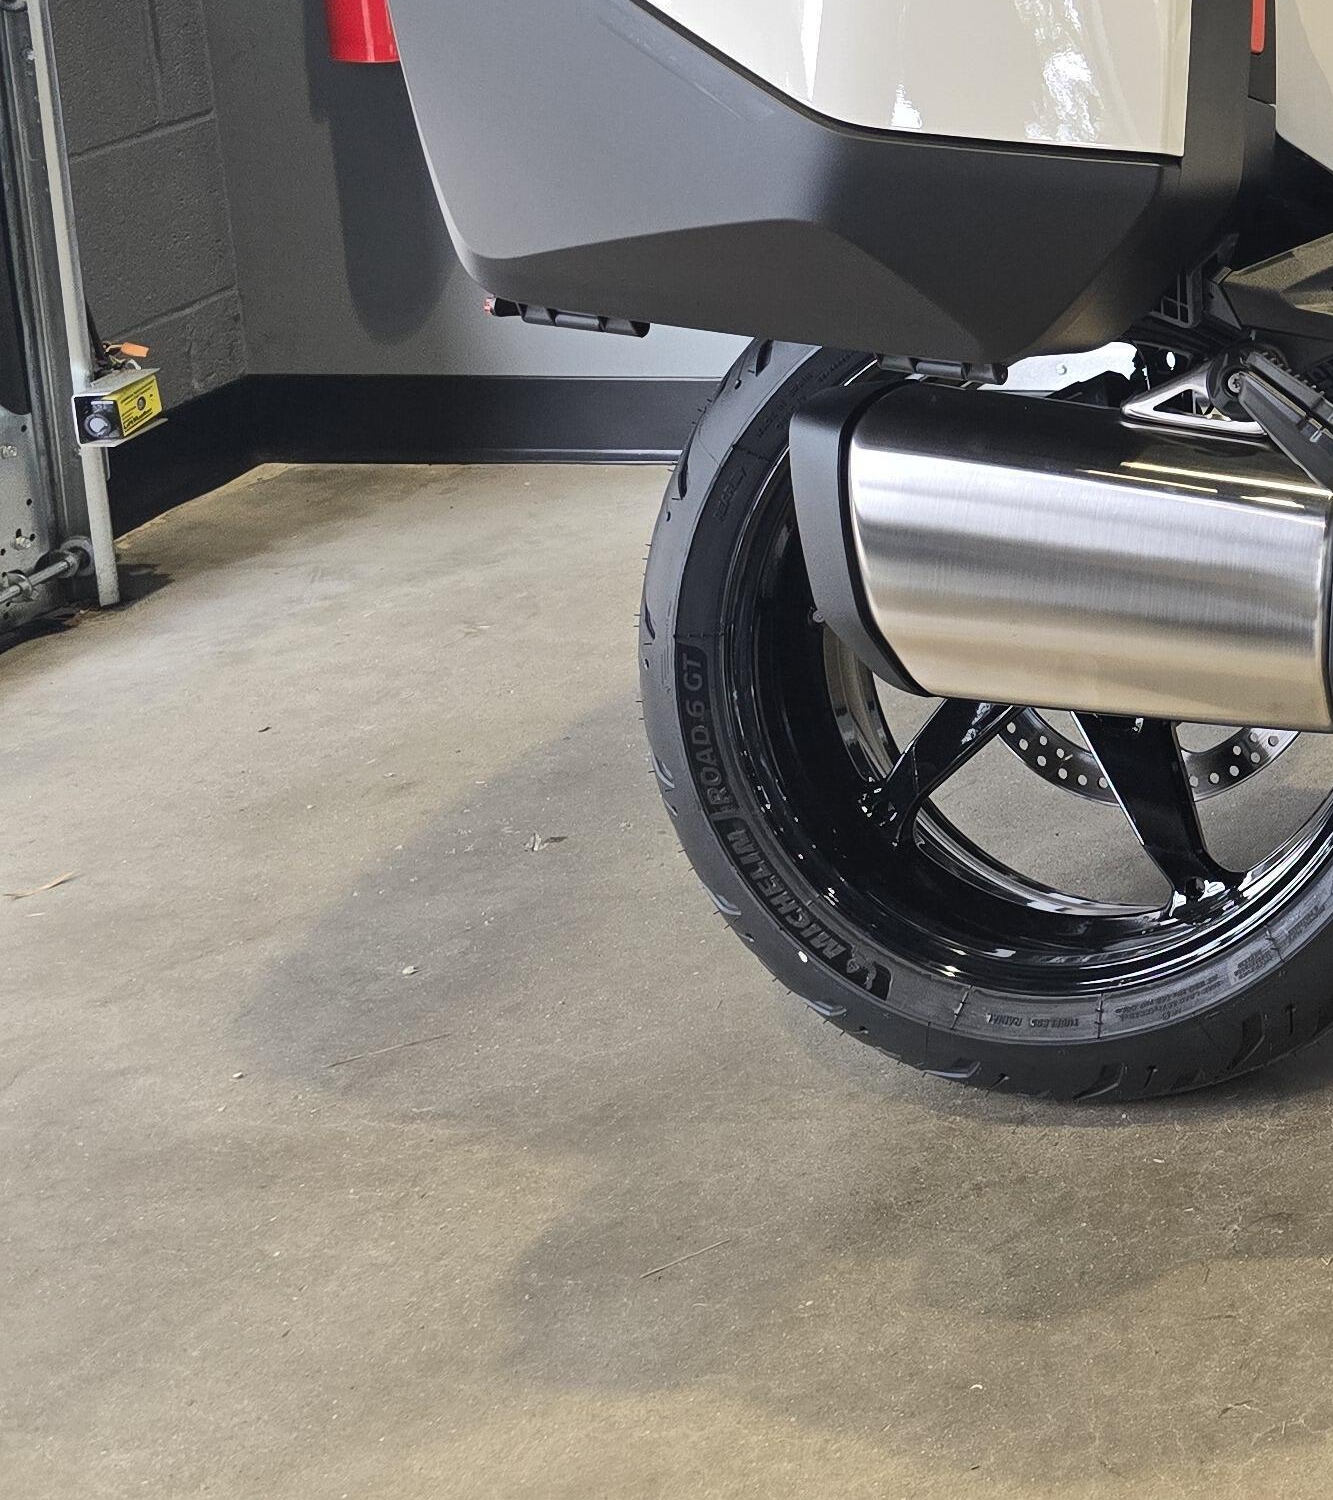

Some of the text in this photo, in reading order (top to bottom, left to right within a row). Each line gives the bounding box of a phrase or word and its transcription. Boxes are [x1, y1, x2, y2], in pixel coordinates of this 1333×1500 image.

[682, 652, 847, 960] MICHELIN ROAD 6 GT
